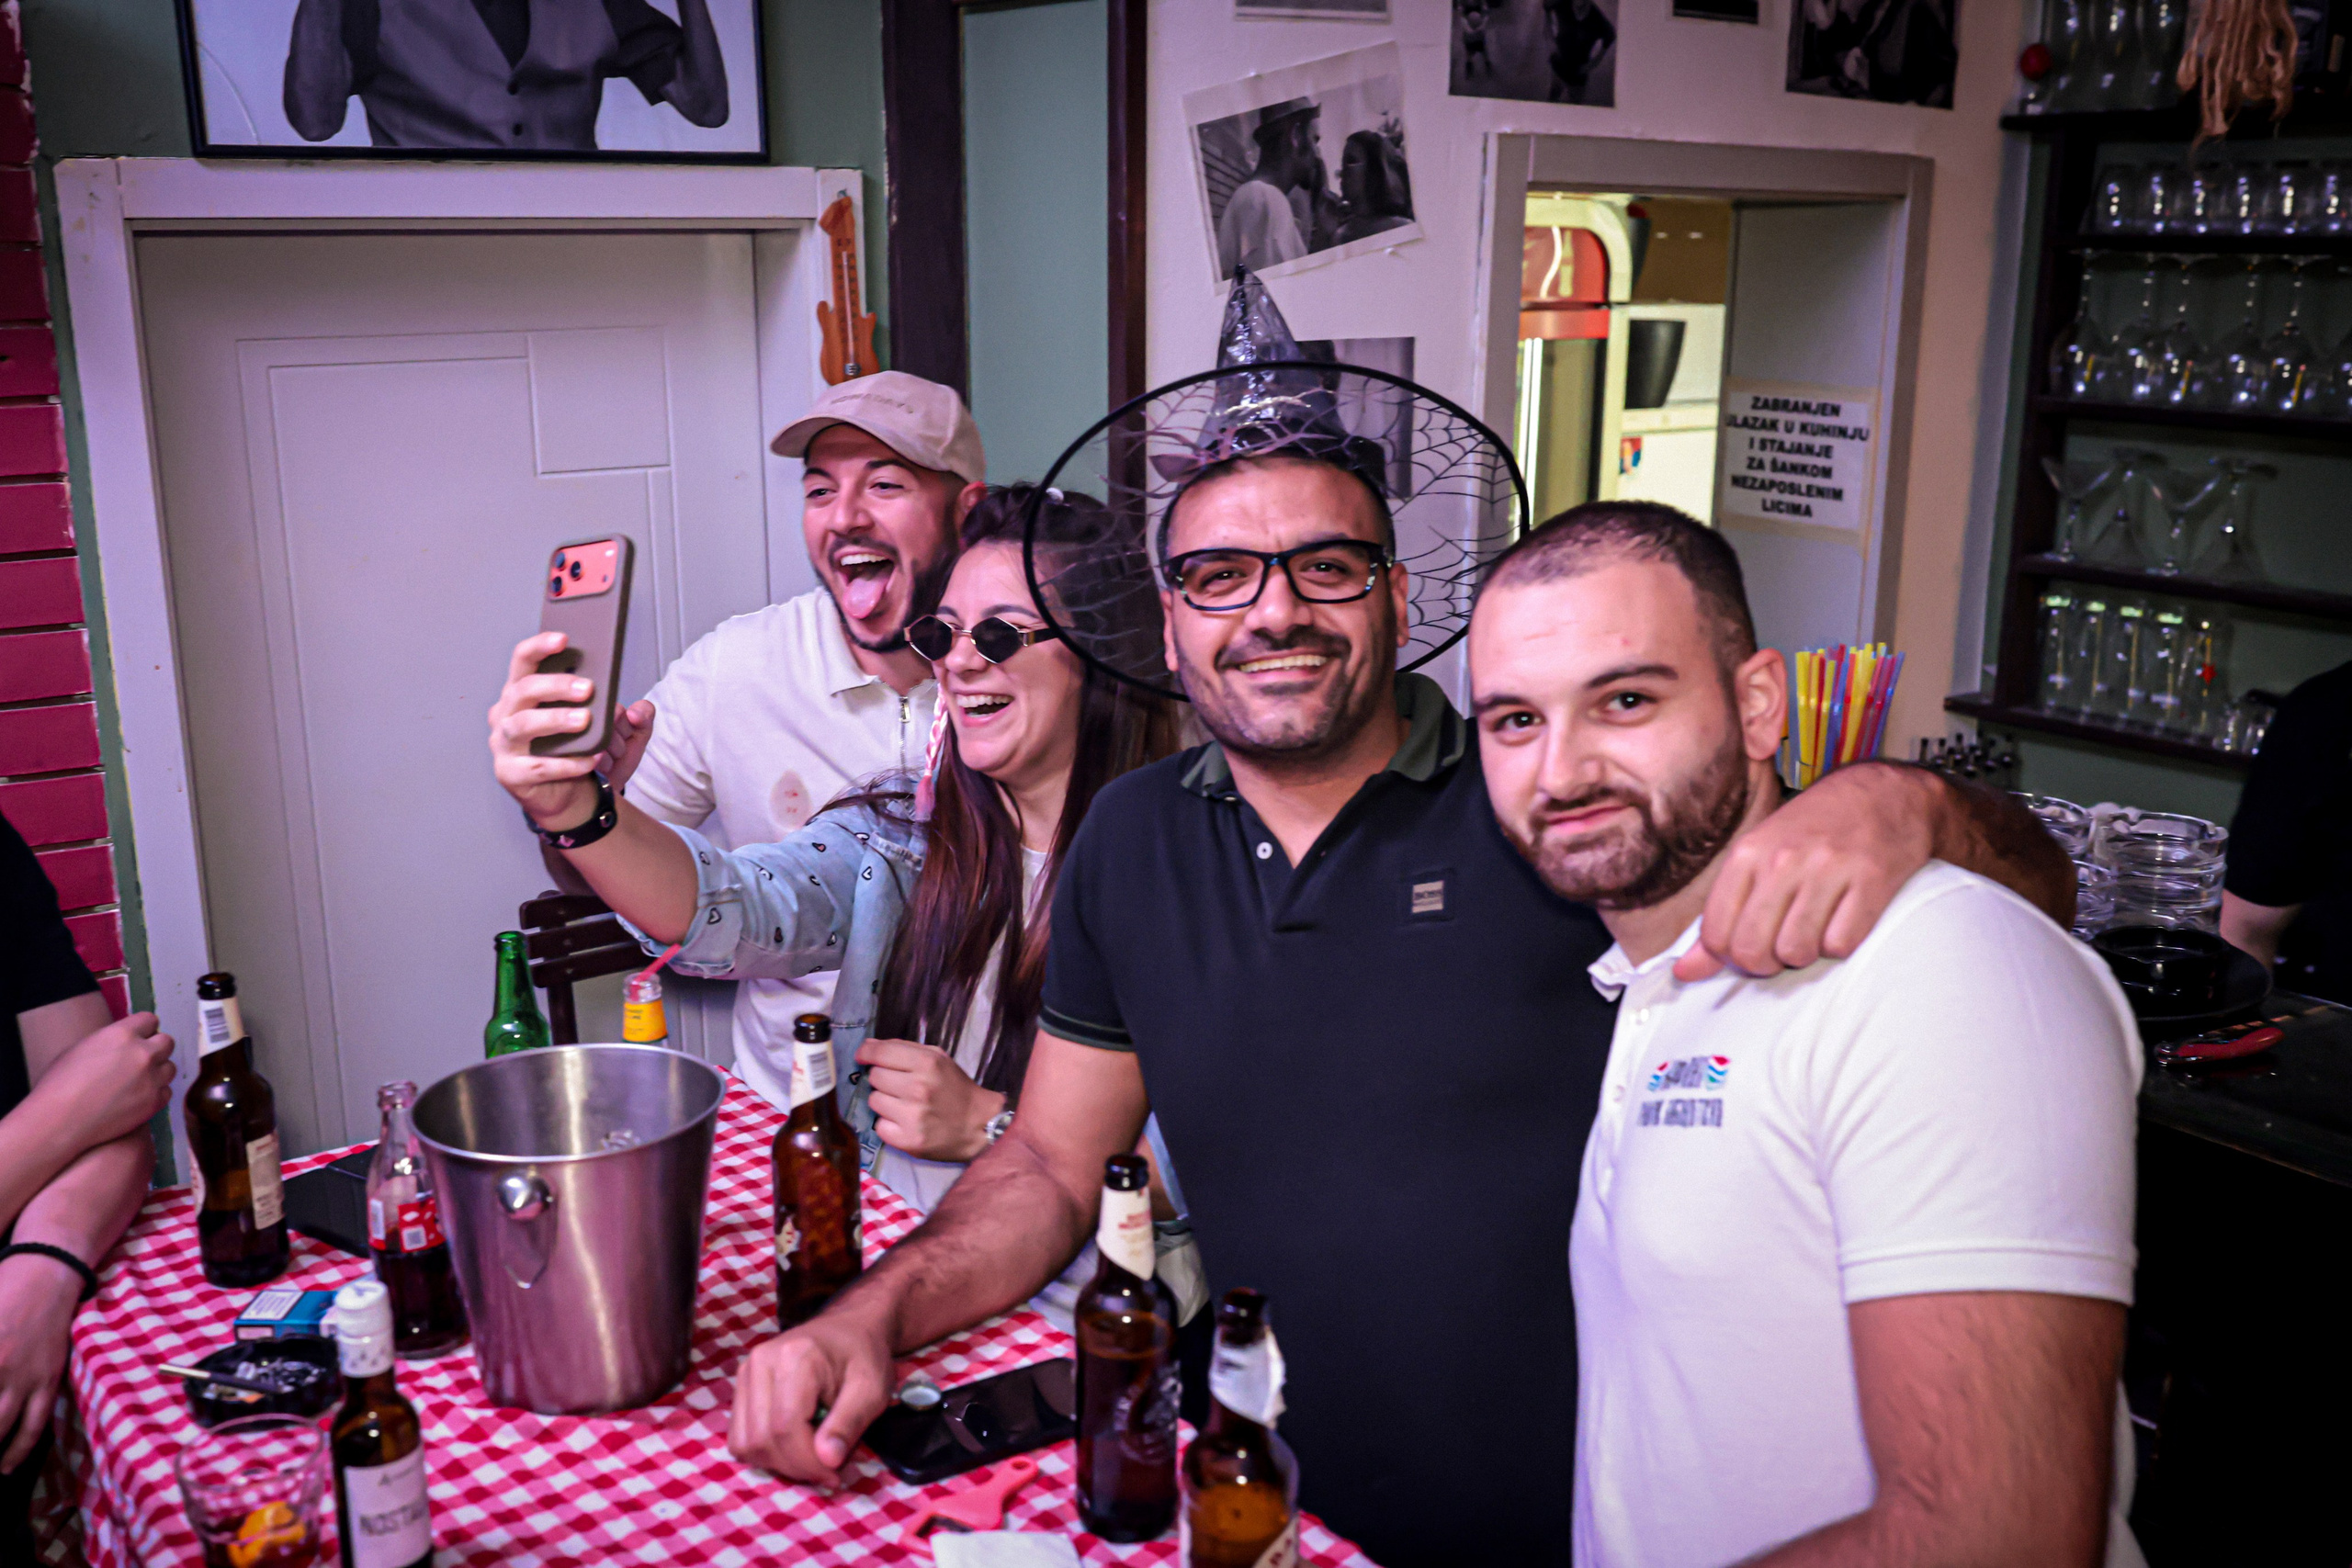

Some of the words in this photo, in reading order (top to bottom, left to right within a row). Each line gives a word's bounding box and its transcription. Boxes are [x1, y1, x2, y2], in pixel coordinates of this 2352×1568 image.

[1751, 396, 1841, 417] ZABRANJEN
[1784, 420, 1794, 434] U
[1800, 421, 1869, 441] KUHINJU
[1749, 436, 1754, 449] I
[1758, 438, 1834, 458] STAJANJE
[1747, 457, 1765, 470] ZA
[1771, 457, 1832, 479] ŠANKOM
[1732, 475, 1843, 501] NEZAPOSLENIM
[1762, 499, 1812, 517] LICIMA
